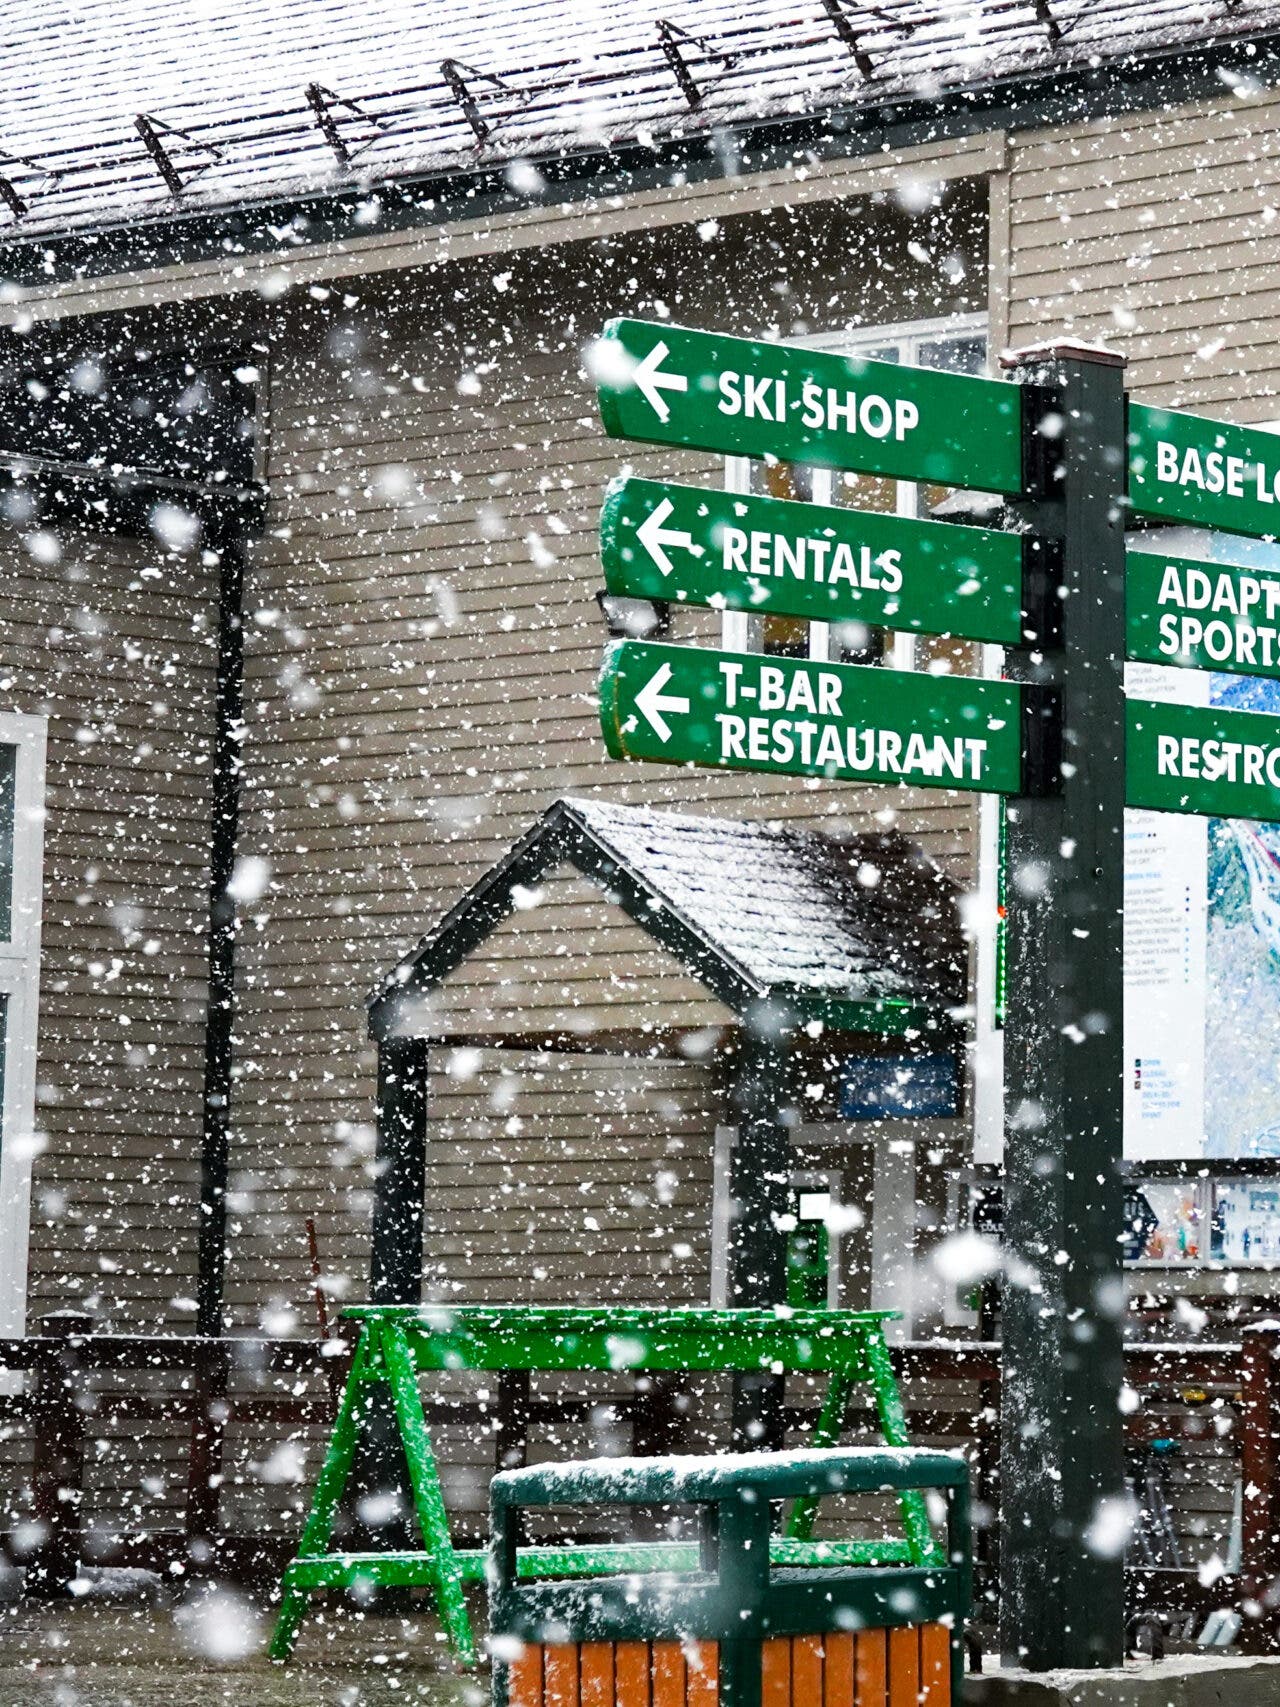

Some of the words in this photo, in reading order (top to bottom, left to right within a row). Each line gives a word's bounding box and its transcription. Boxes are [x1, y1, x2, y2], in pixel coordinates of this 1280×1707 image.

[718, 370, 786, 423] SKI
[801, 384, 919, 441] SHOP
[1157, 441, 1244, 497] BASE
[723, 527, 903, 592] RENTALS
[719, 661, 843, 717] T-BAR
[720, 715, 987, 780] RESTAURANT
